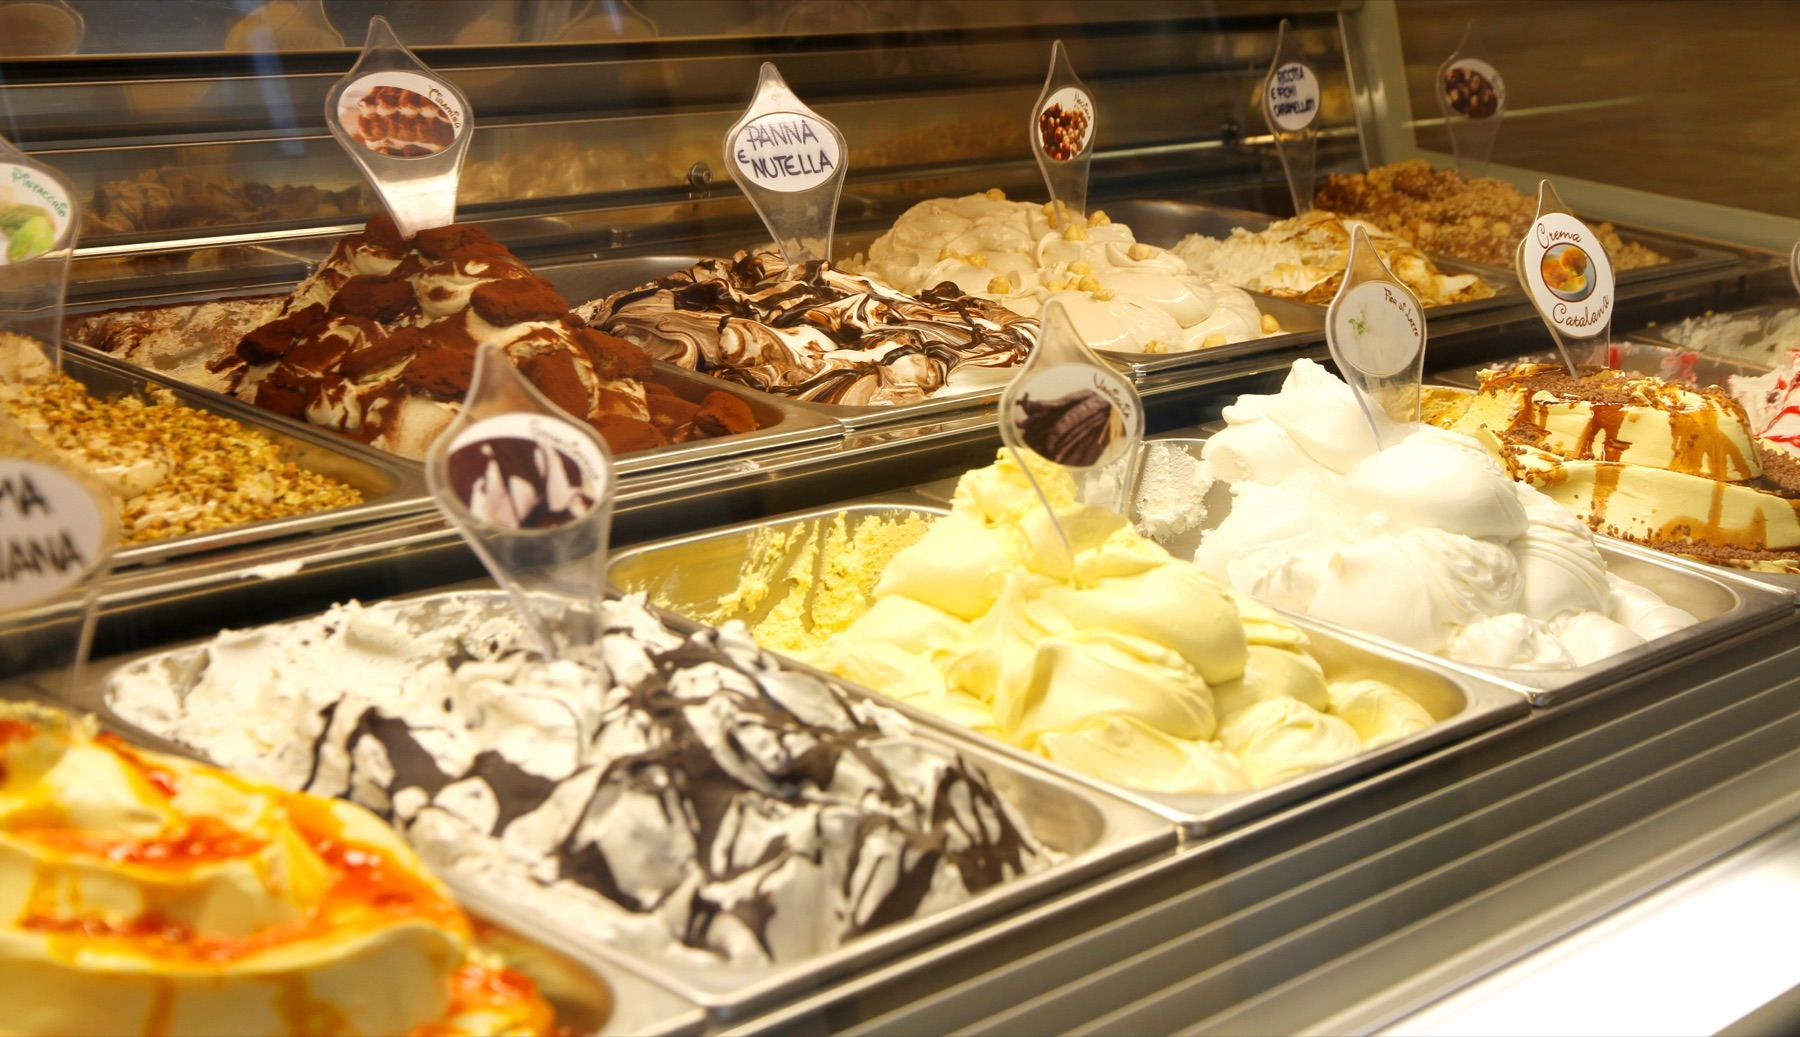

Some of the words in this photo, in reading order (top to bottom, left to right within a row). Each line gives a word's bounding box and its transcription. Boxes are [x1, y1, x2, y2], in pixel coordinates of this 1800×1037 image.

[744, 119, 819, 151] PANNA
[751, 149, 834, 179] NUTELLA
[1537, 223, 1582, 249] Crema
[1553, 295, 1610, 328] Catalana
